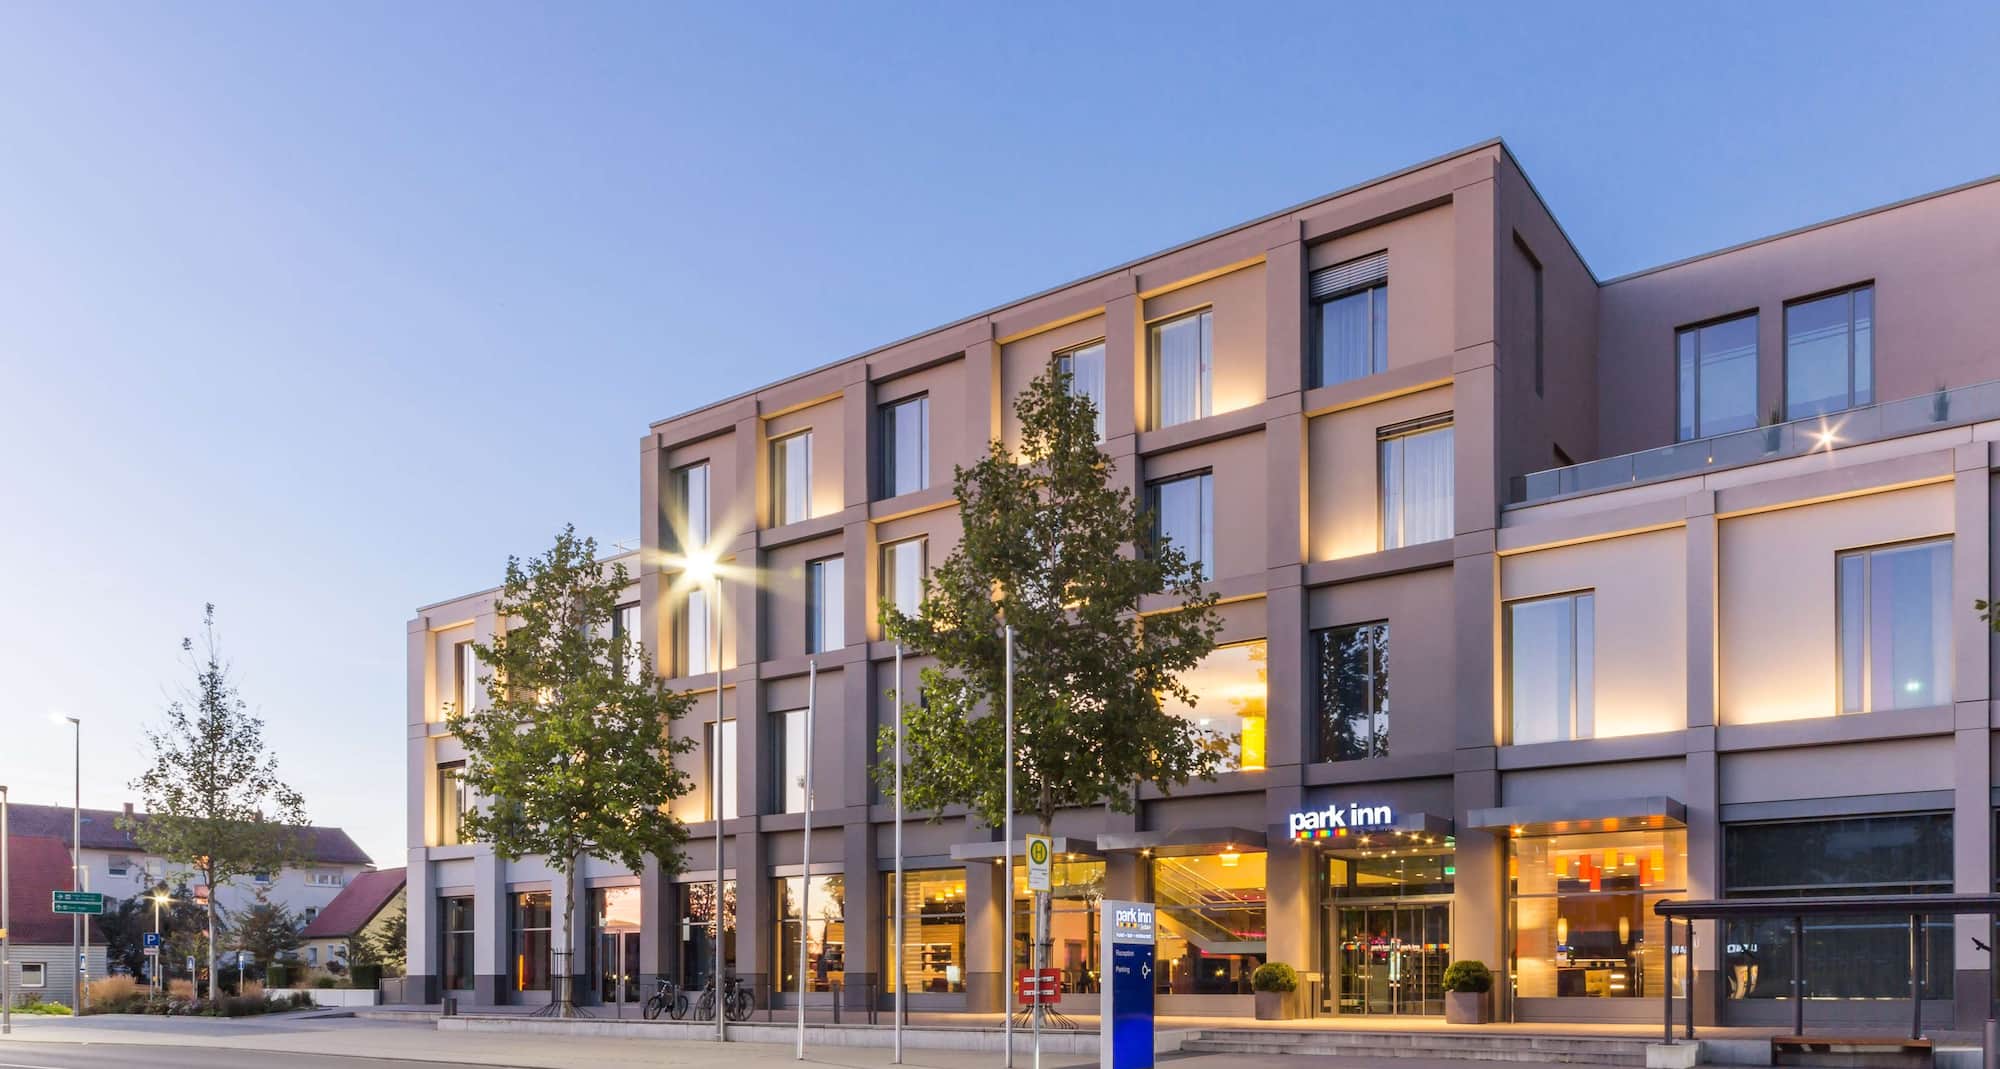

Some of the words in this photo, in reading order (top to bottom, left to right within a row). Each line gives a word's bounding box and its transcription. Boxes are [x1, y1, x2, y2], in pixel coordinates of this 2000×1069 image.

[1290, 805, 1346, 838] park
[1350, 803, 1392, 826] inn
[1116, 907, 1137, 927] park
[1137, 908, 1152, 923] inn
[147, 934, 156, 945] P
